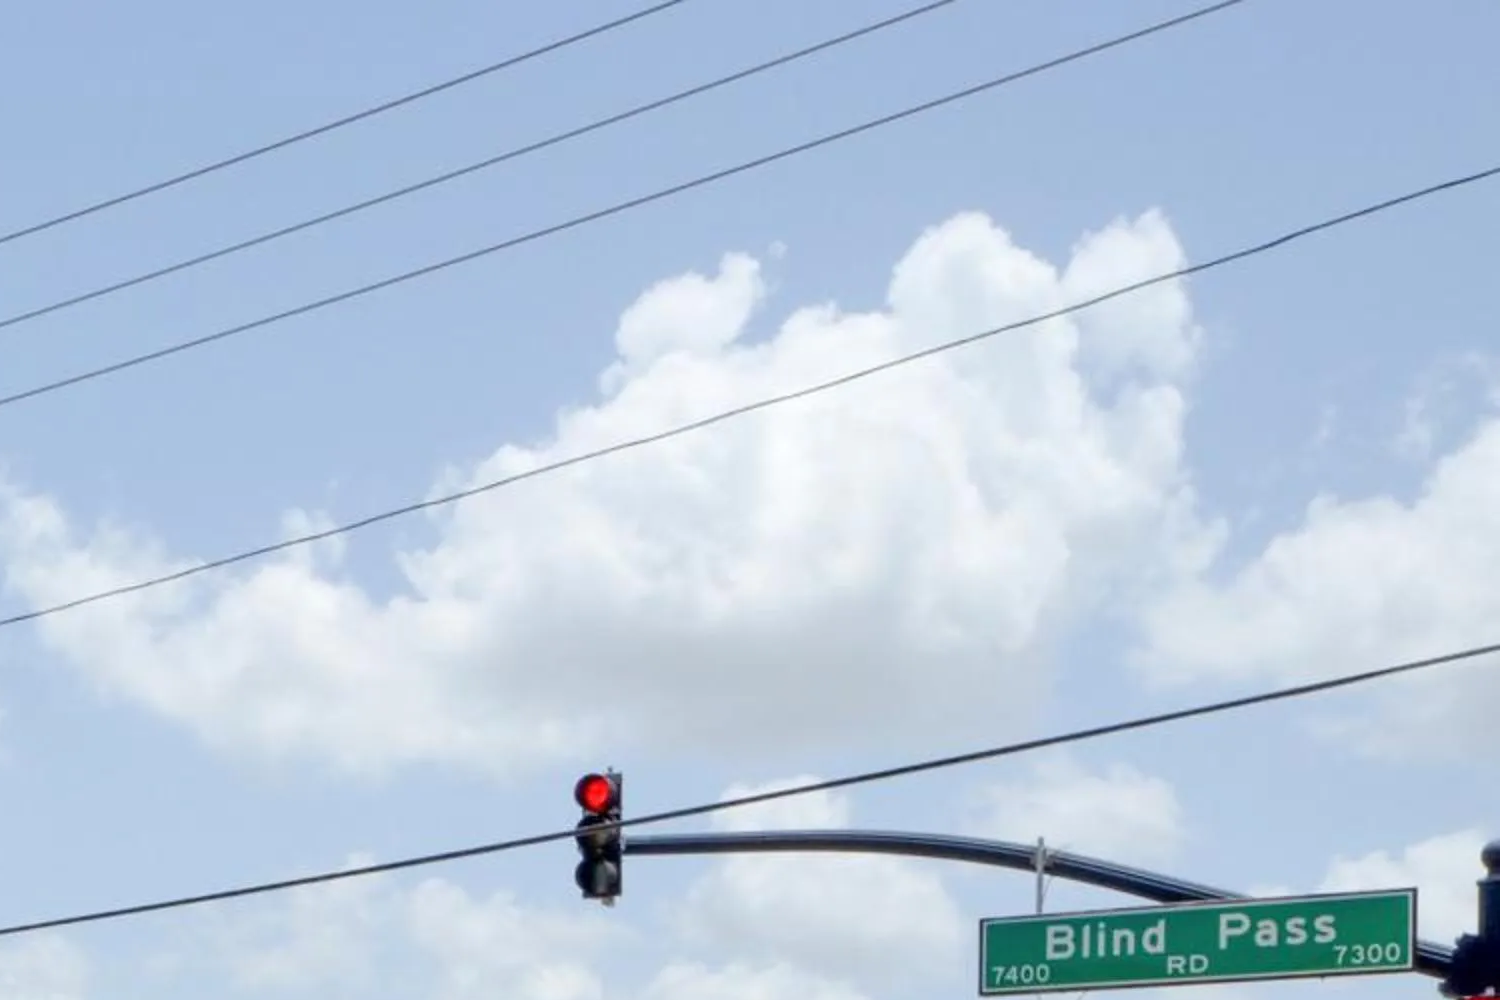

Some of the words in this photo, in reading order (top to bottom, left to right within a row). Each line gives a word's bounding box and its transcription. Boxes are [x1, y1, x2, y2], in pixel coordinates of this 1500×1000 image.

[1045, 919, 1166, 960] Blind
[1219, 912, 1337, 950] Pass
[1333, 943, 1401, 965] 7300
[992, 964, 1049, 985] 7400
[1167, 955, 1210, 976] RD
